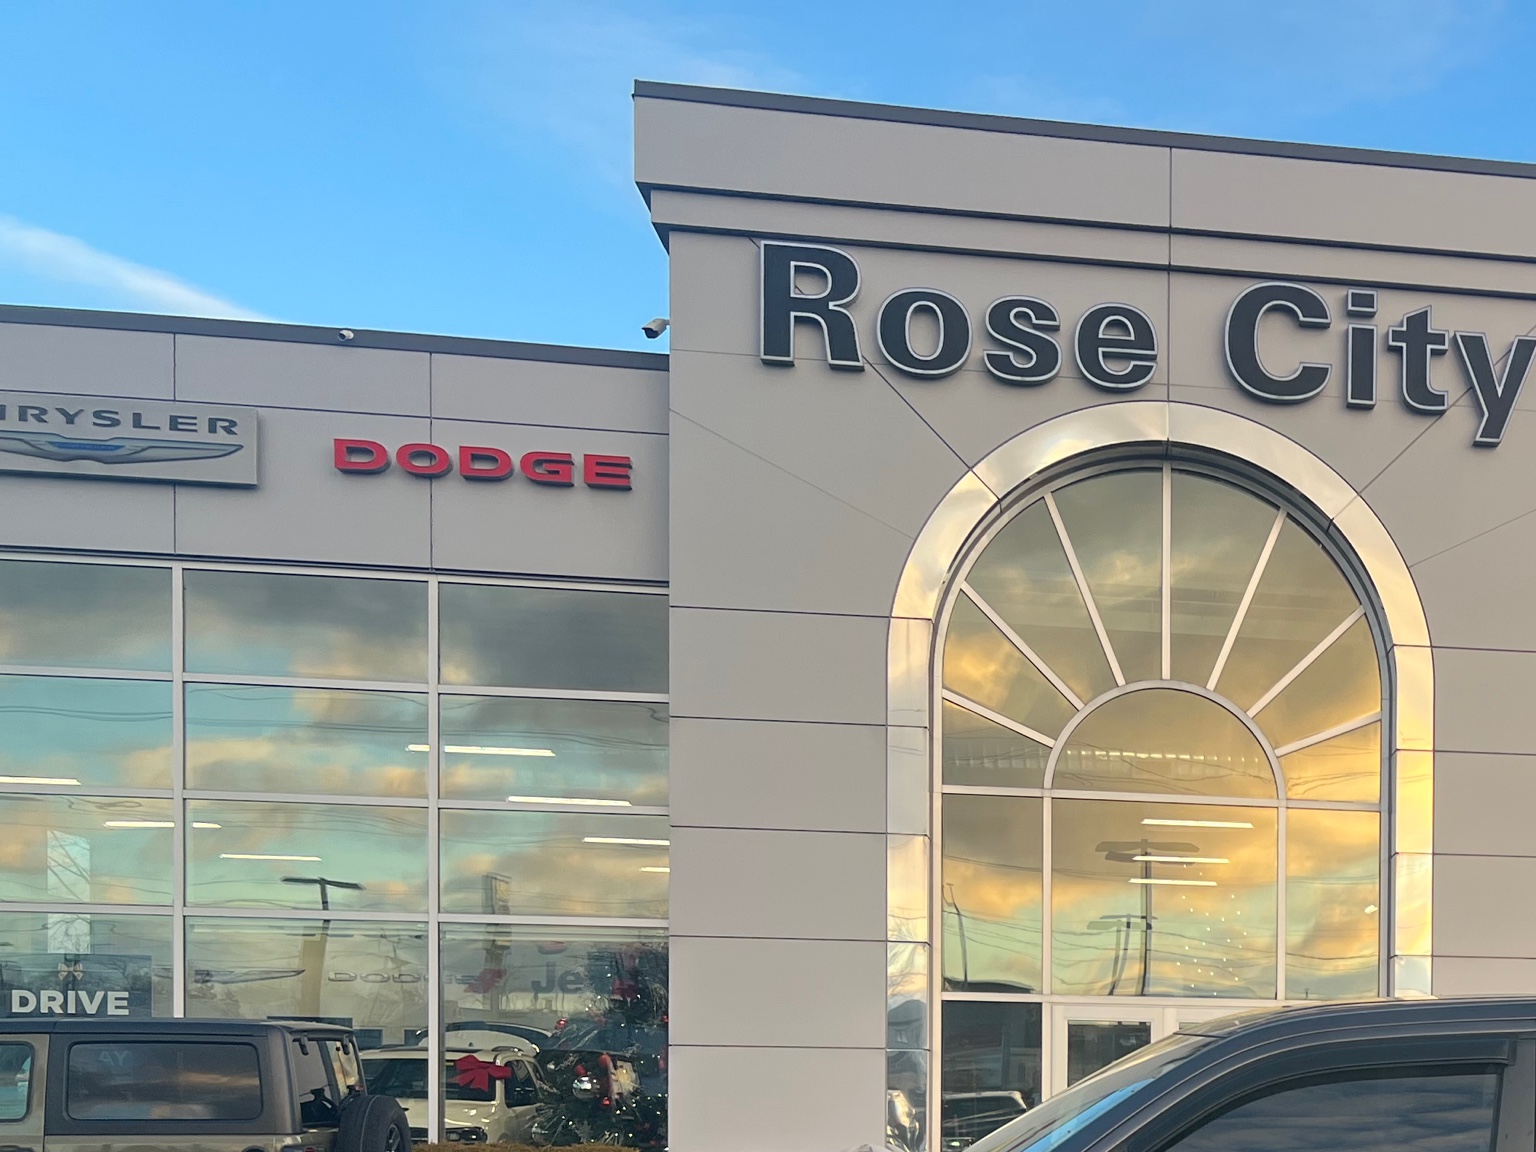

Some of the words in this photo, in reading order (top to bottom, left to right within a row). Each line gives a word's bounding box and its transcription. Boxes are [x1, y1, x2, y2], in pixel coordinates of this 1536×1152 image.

[758, 240, 1159, 391] Rose
[0, 404, 239, 436] RYSLER
[333, 437, 634, 491] DODGE
[530, 961, 585, 995] Je
[10, 989, 130, 1016] DRIVE
